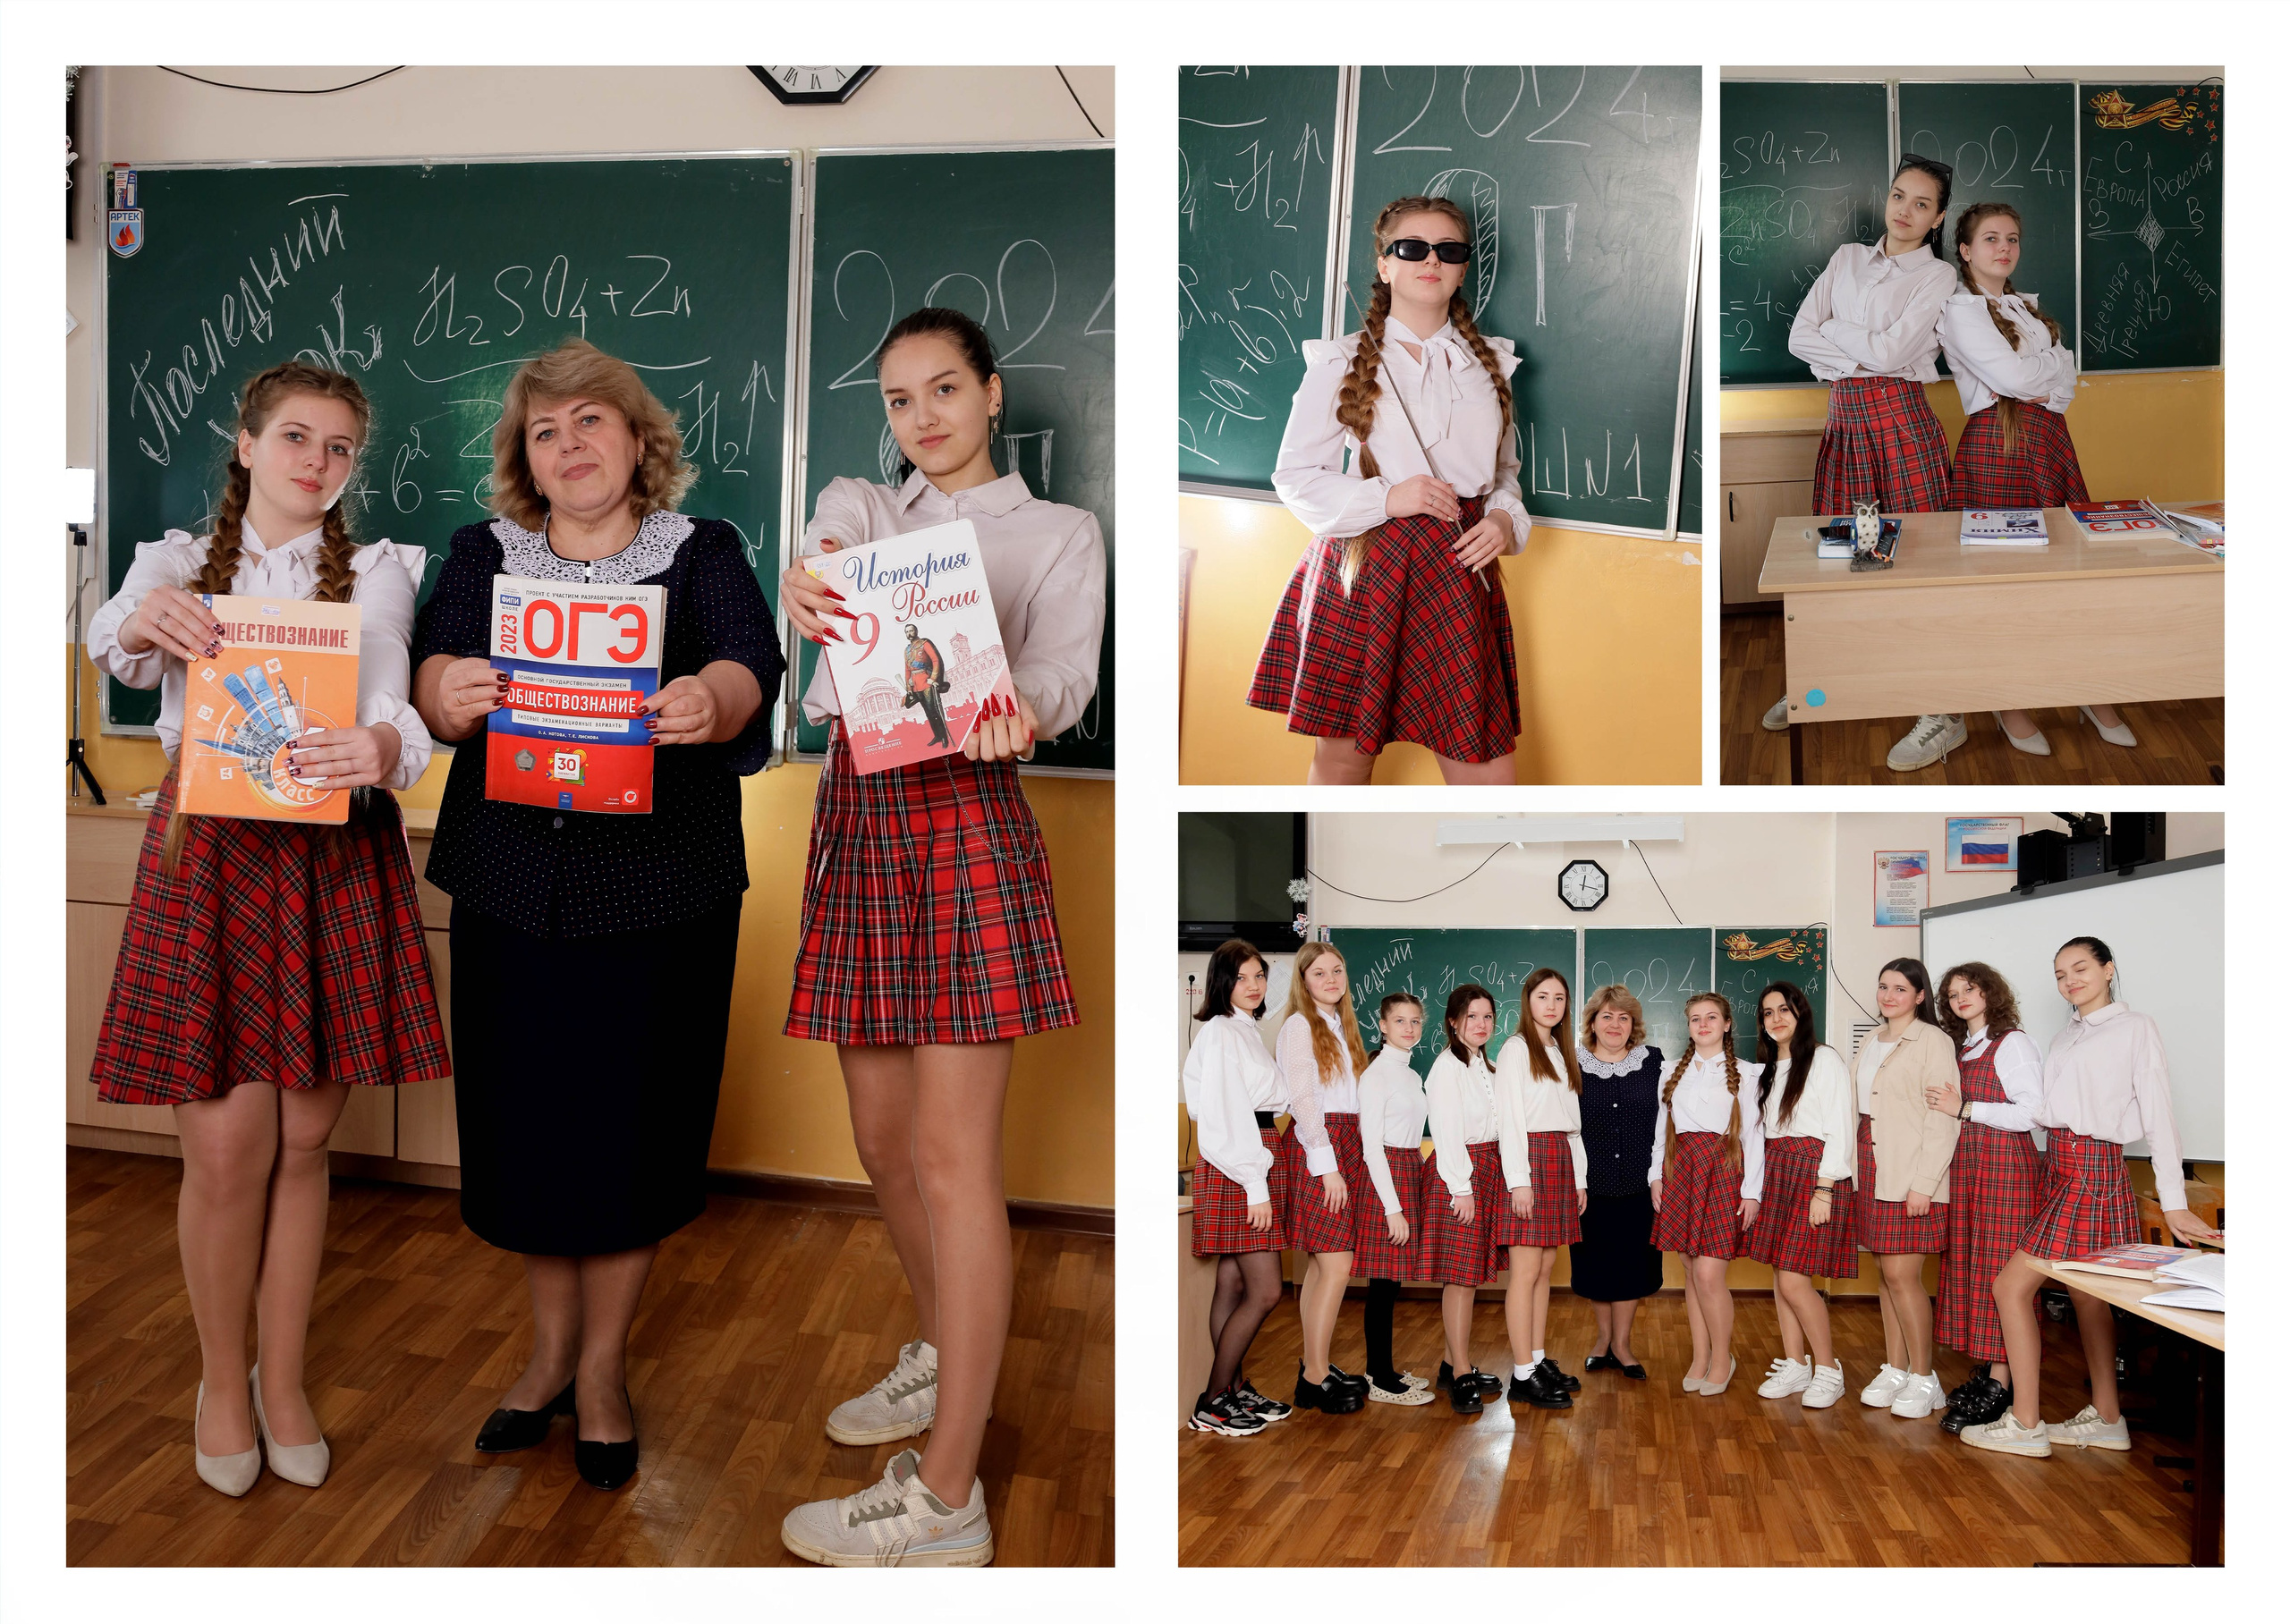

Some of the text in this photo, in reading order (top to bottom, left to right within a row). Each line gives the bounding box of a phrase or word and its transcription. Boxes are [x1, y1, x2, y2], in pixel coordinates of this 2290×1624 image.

[110, 212, 140, 221] АРТЕК
[2089, 520, 2157, 532] ОГЭ
[842, 551, 971, 594] История
[501, 596, 520, 605] ФИПИ
[525, 589, 545, 597] ПРОЕКТ
[552, 592, 579, 600] УЧАСТИЕМ
[581, 594, 623, 602] РАЗРАБОТЧИКОВ
[891, 580, 980, 622] России
[222, 622, 349, 648] ЩЕСТВОЗНАНИЕ
[500, 613, 518, 655] 2023
[523, 599, 649, 664] ОГЭ
[850, 612, 880, 666] 9
[517, 674, 545, 683] ОСНОВНОЙ
[546, 677, 599, 688] ГОСУДАРСТВЕННЫЙ
[507, 687, 637, 714] ОБЩЕСТВОЗНАНИЕ
[517, 714, 623, 729] ТИПОВЫЕ ЭКЗАМЕНАЦИОННЫЕ ВАРИАНТЫ
[557, 757, 577, 772] 30
